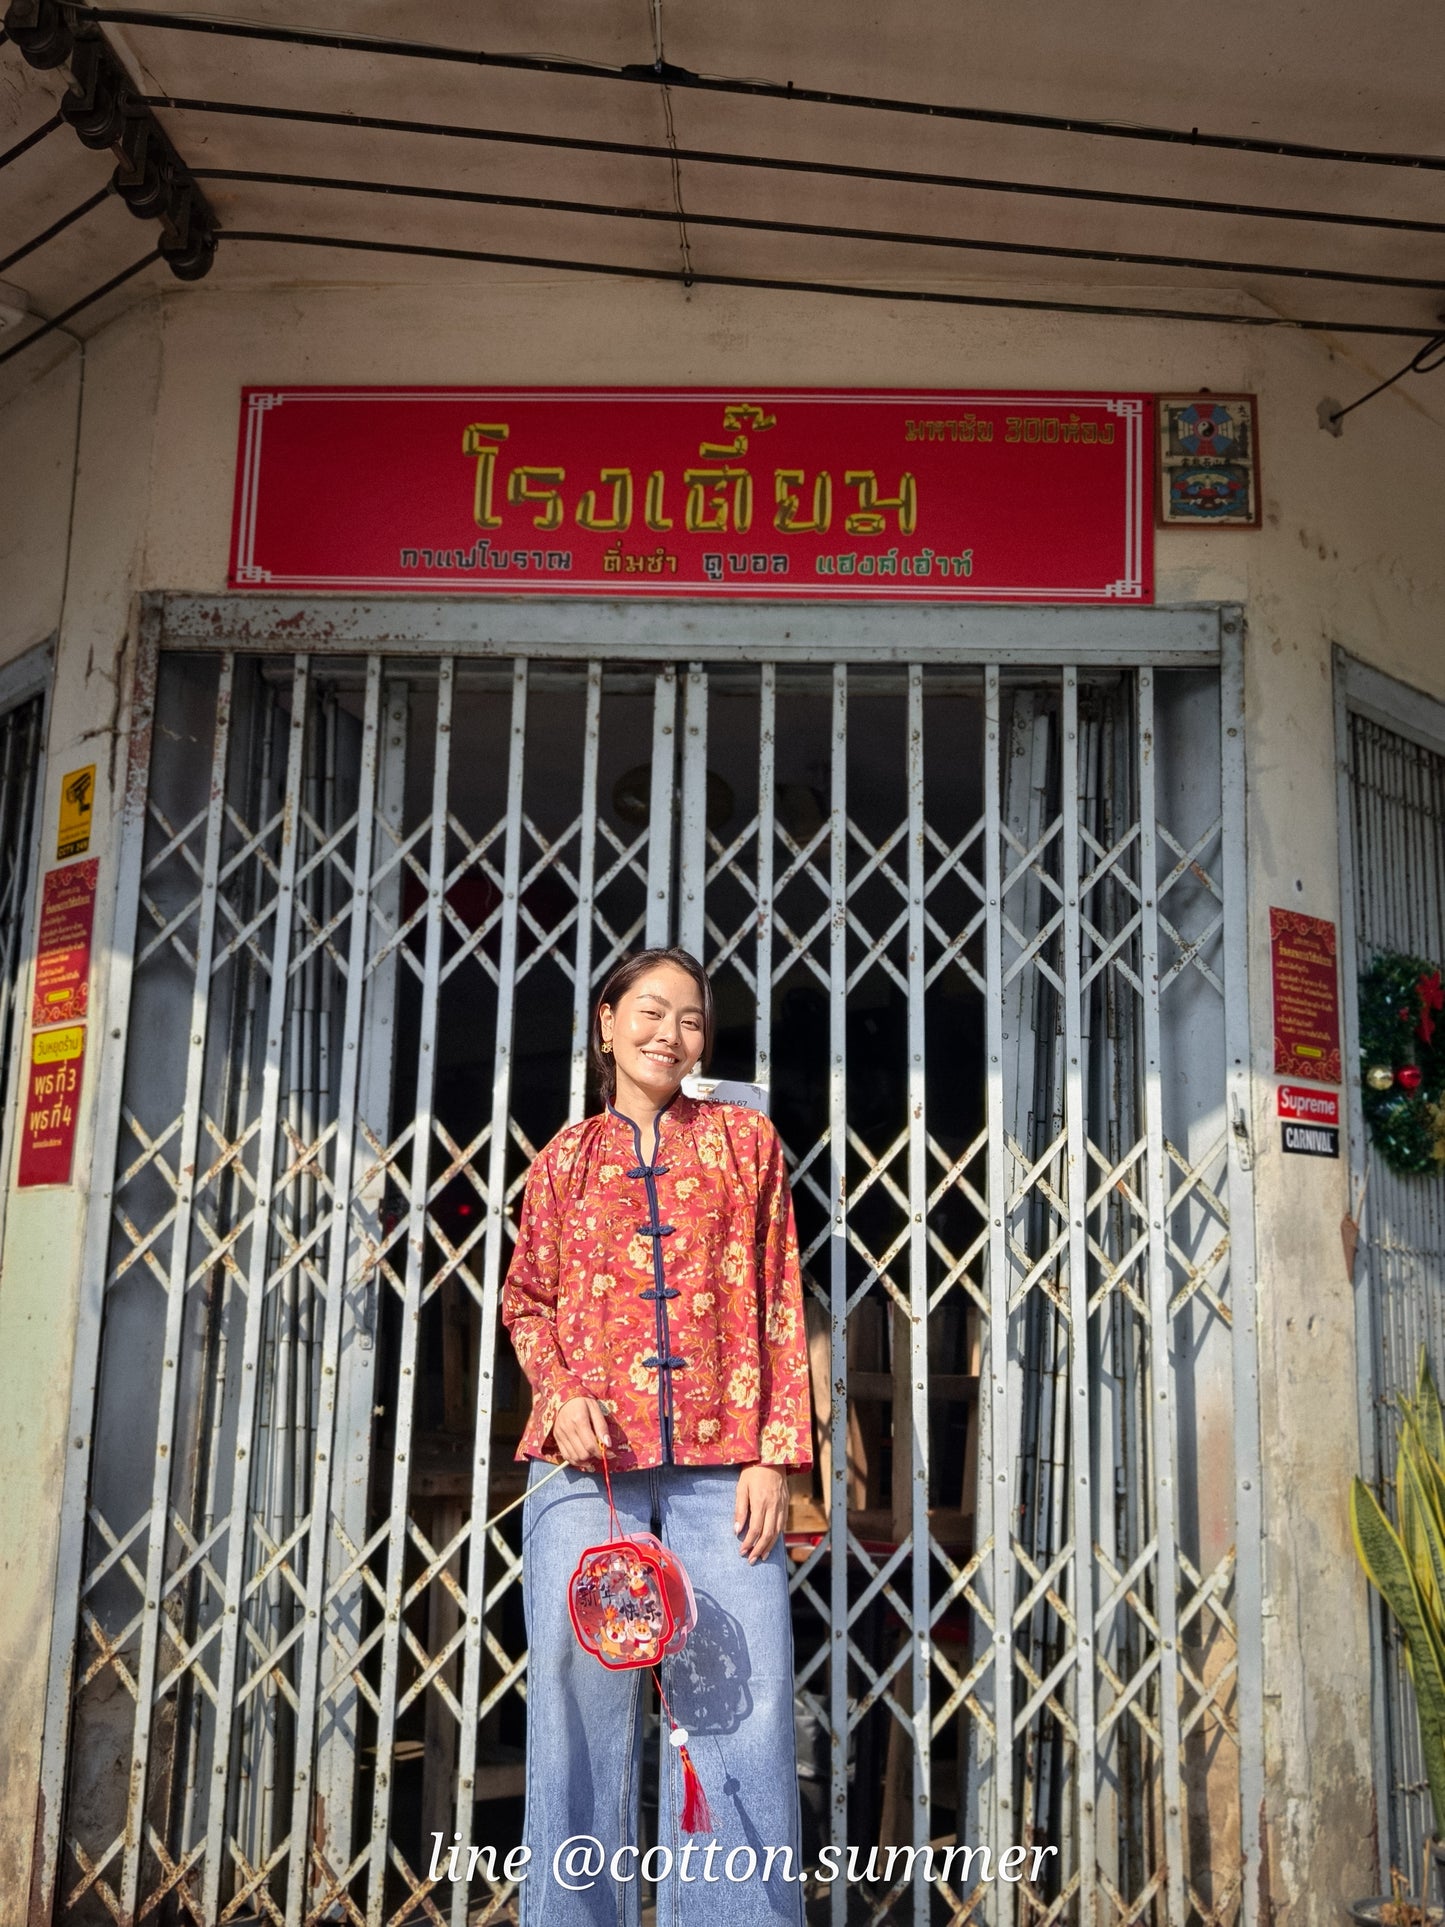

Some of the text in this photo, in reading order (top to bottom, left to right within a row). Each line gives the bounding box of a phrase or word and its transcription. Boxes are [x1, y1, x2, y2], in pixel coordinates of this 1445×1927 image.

[905, 413, 993, 442] มหาชัย
[462, 403, 917, 536] โรงเตี๊ยม
[400, 539, 572, 570] กาแฟโบราณ
[602, 540, 678, 573] ติ่มซำ
[702, 552, 789, 580] ดูบอล
[38, 1034, 79, 1056] วันหยุดร้าน
[1281, 1088, 1335, 1116] Supreme
